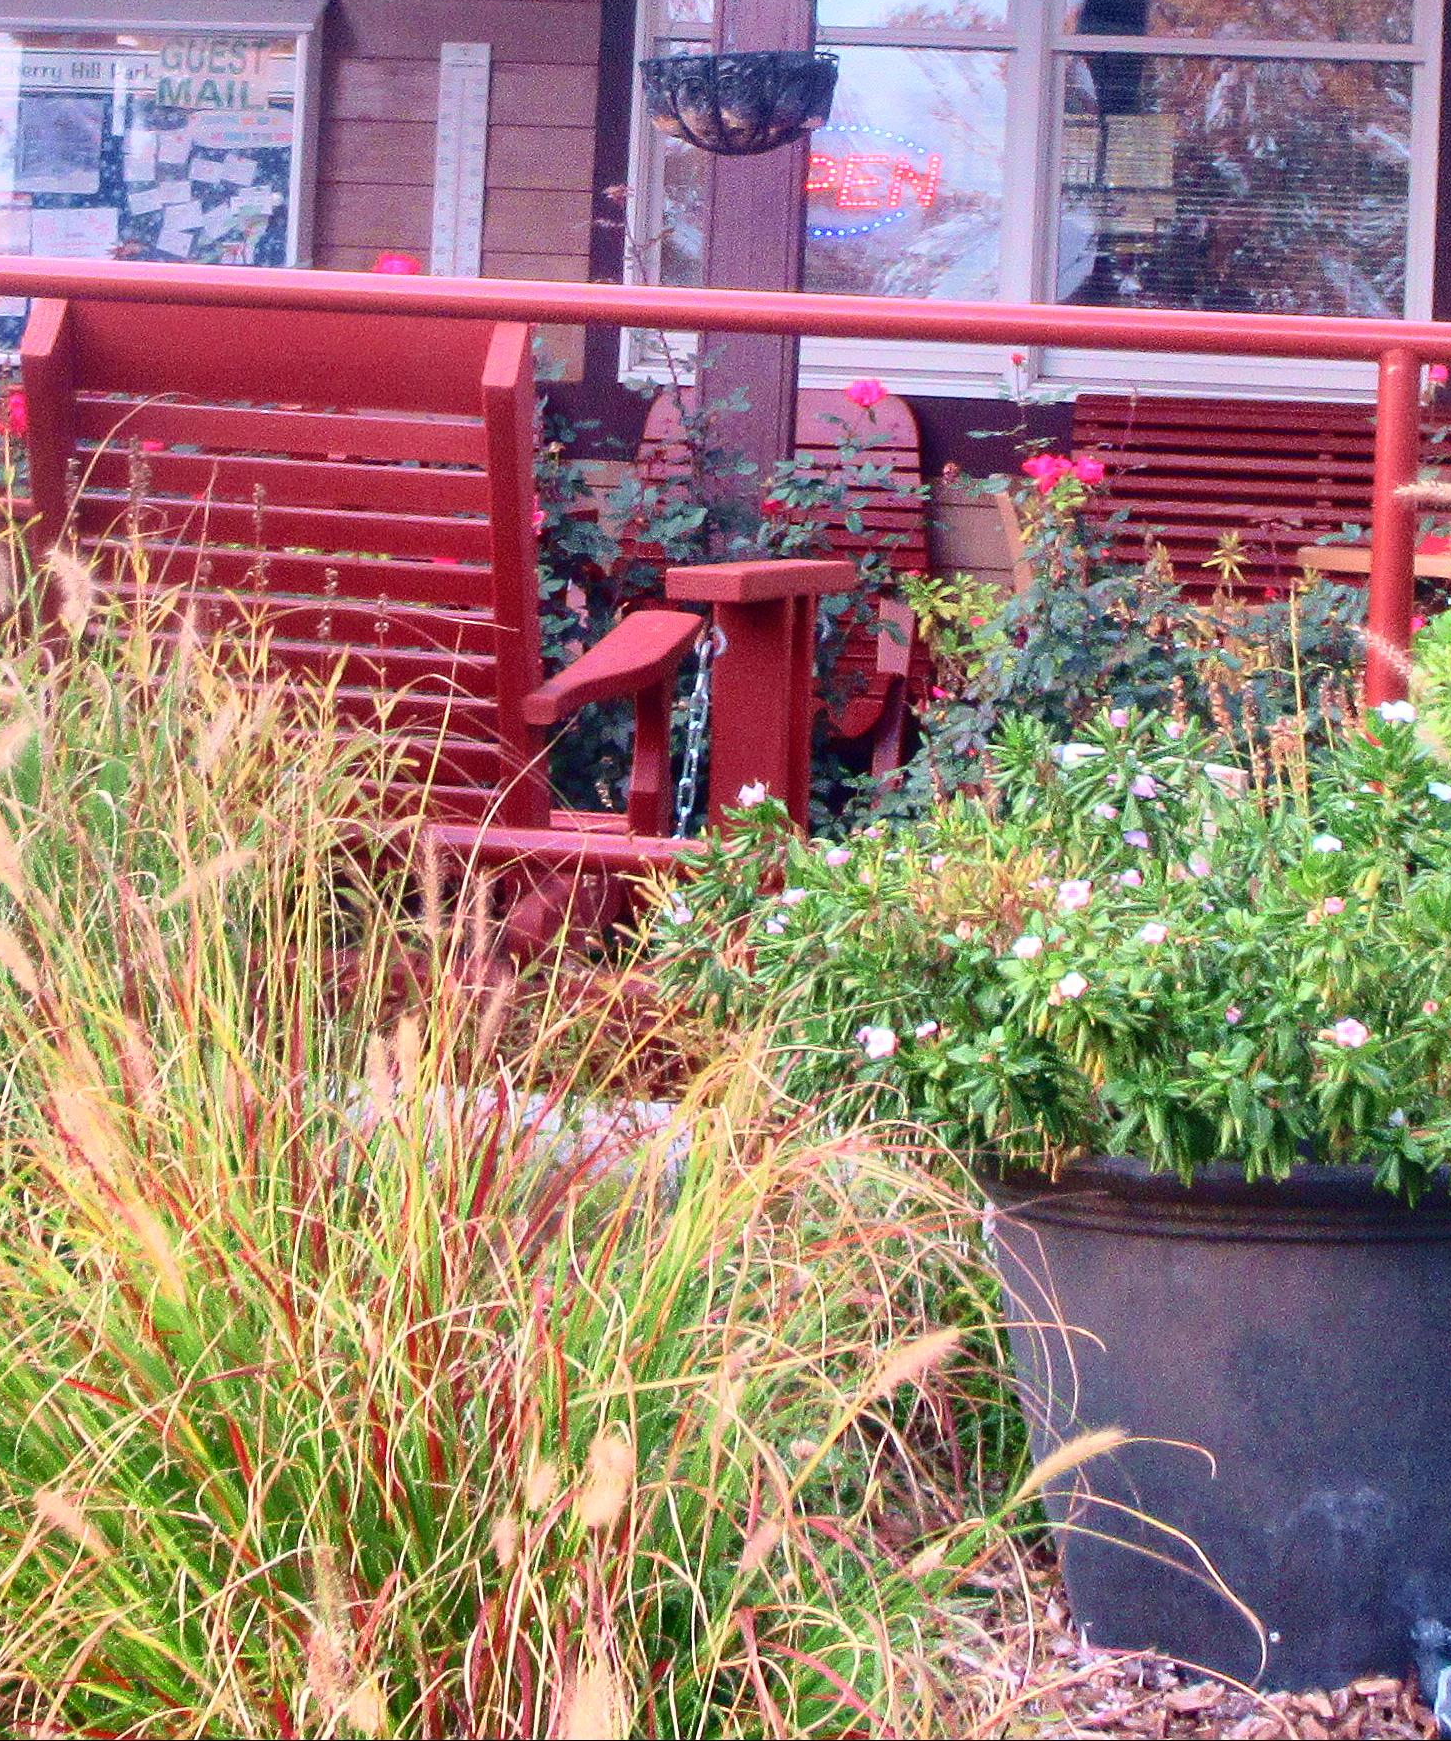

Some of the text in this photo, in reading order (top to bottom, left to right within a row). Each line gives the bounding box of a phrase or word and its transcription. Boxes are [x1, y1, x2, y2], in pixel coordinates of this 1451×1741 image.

[70, 62, 101, 79] Hill
[160, 38, 269, 75] GUEST
[157, 76, 265, 109] MAIL
[806, 154, 942, 207] PEN
